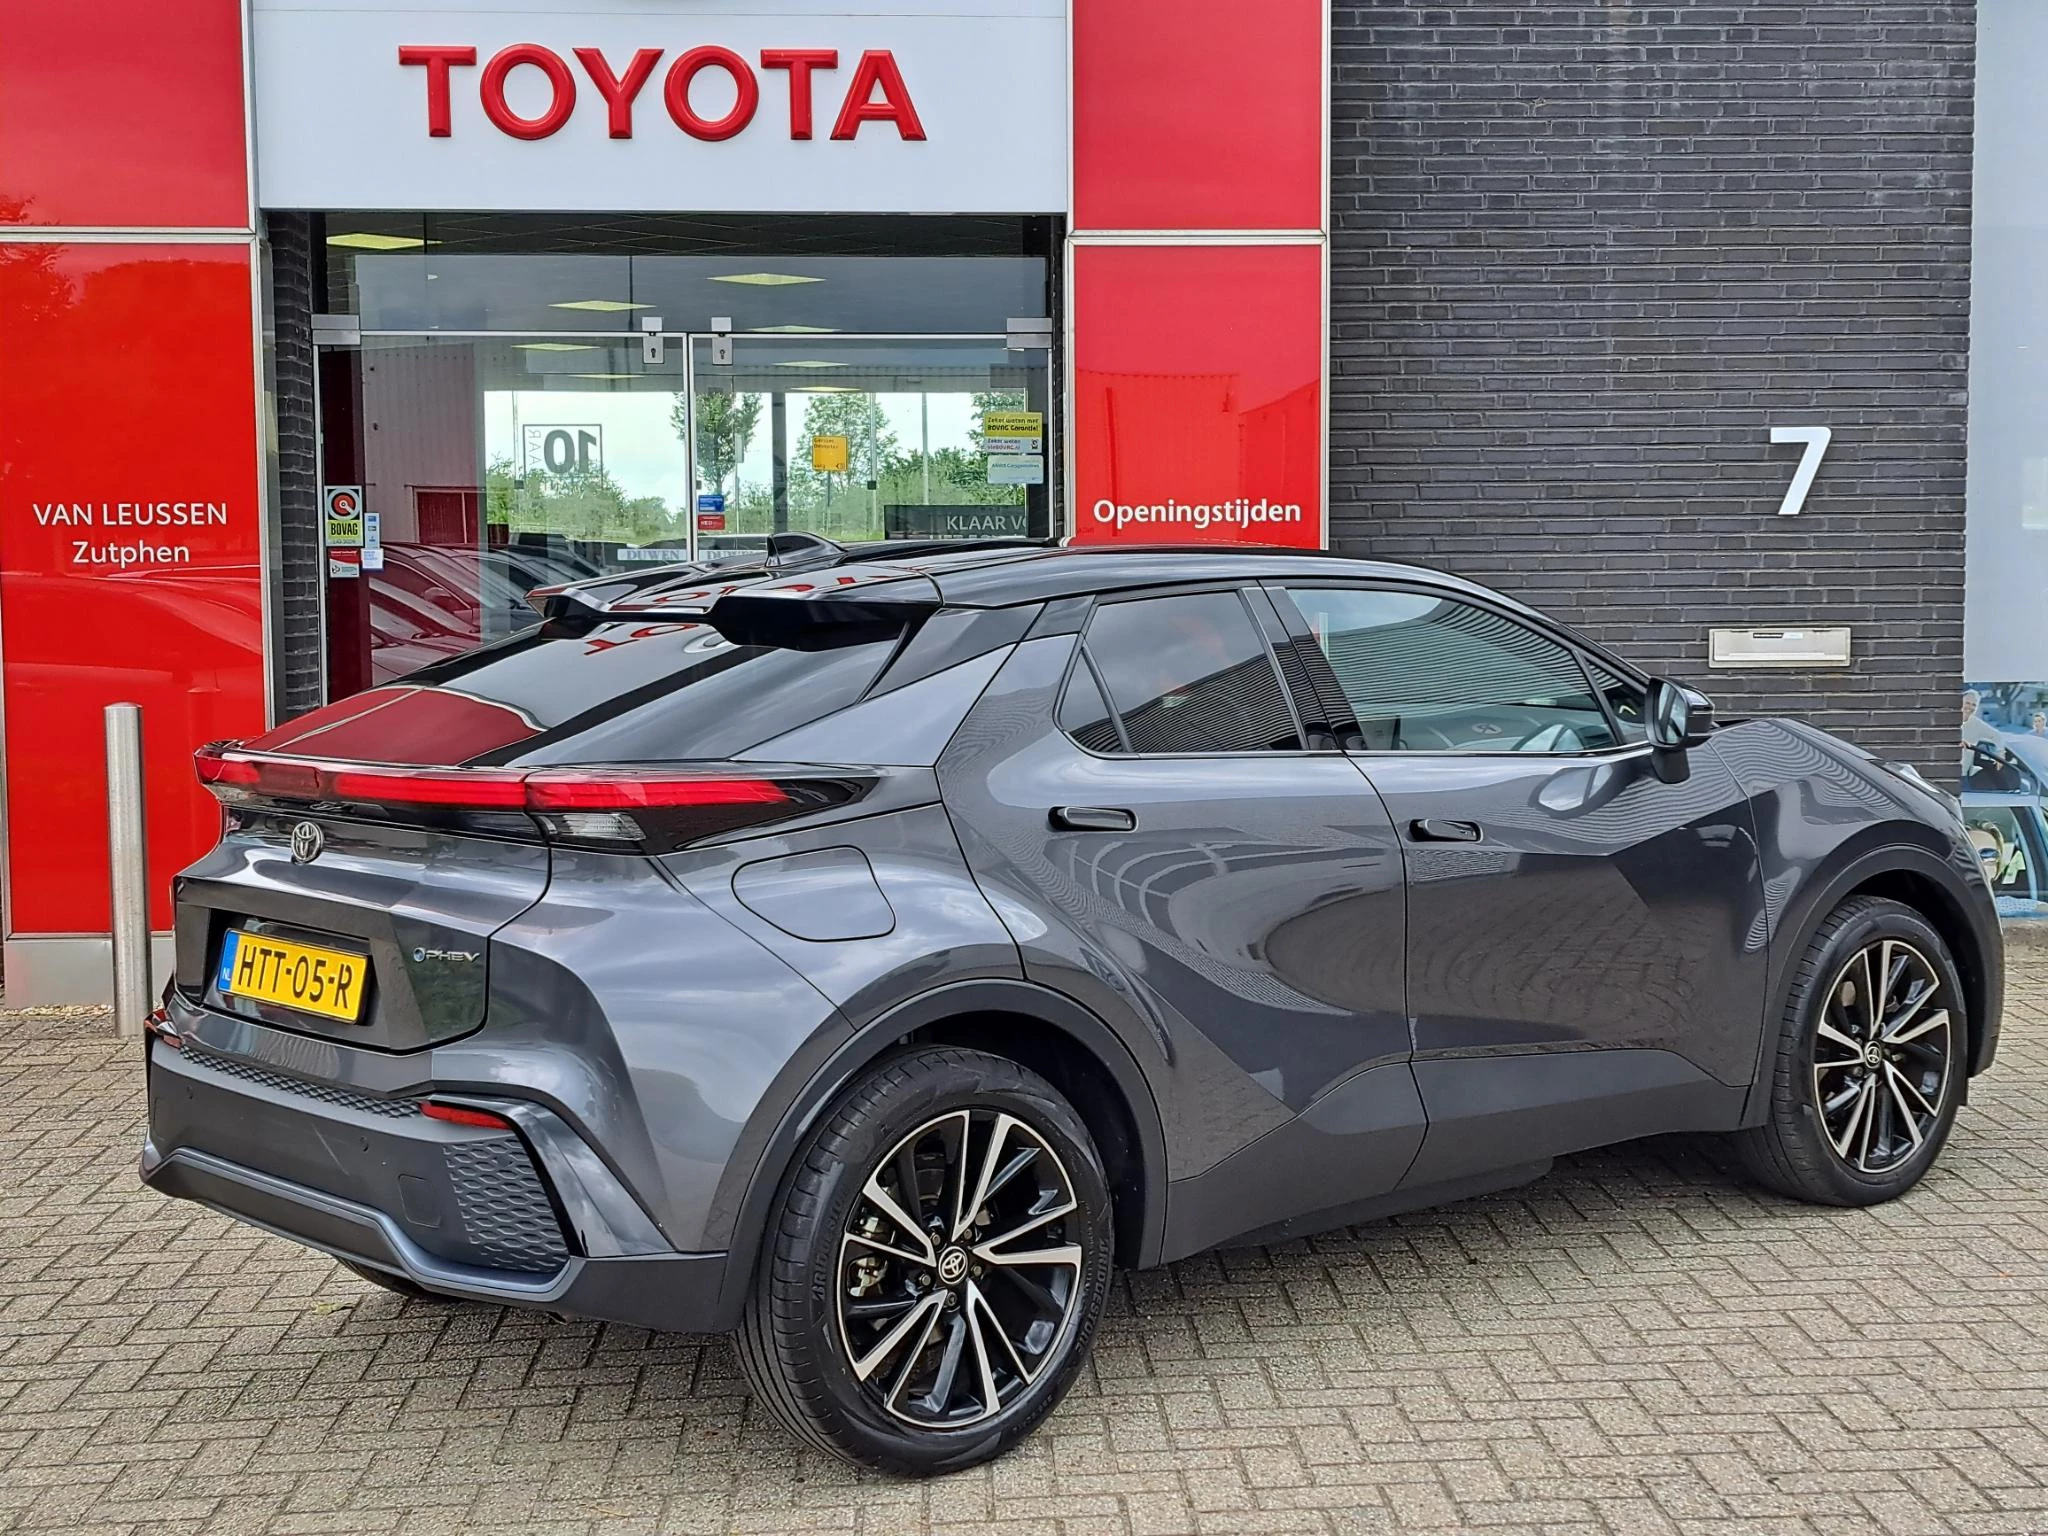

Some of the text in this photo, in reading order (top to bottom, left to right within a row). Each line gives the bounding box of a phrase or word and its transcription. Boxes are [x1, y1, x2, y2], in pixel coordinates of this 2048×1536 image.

[398, 43, 928, 142] TOYOTA
[1770, 427, 1832, 516] 7
[32, 502, 227, 526] VAN LEUSSEN
[946, 515, 1006, 531] KLAAR
[1093, 498, 1302, 530] Openingstijden
[331, 522, 358, 536] BOVAG
[72, 539, 190, 569] Zutphen
[626, 550, 680, 560] DUWEN
[425, 950, 480, 962] PHEV
[222, 968, 231, 981] NL
[237, 944, 354, 1010] HTT-05-R
